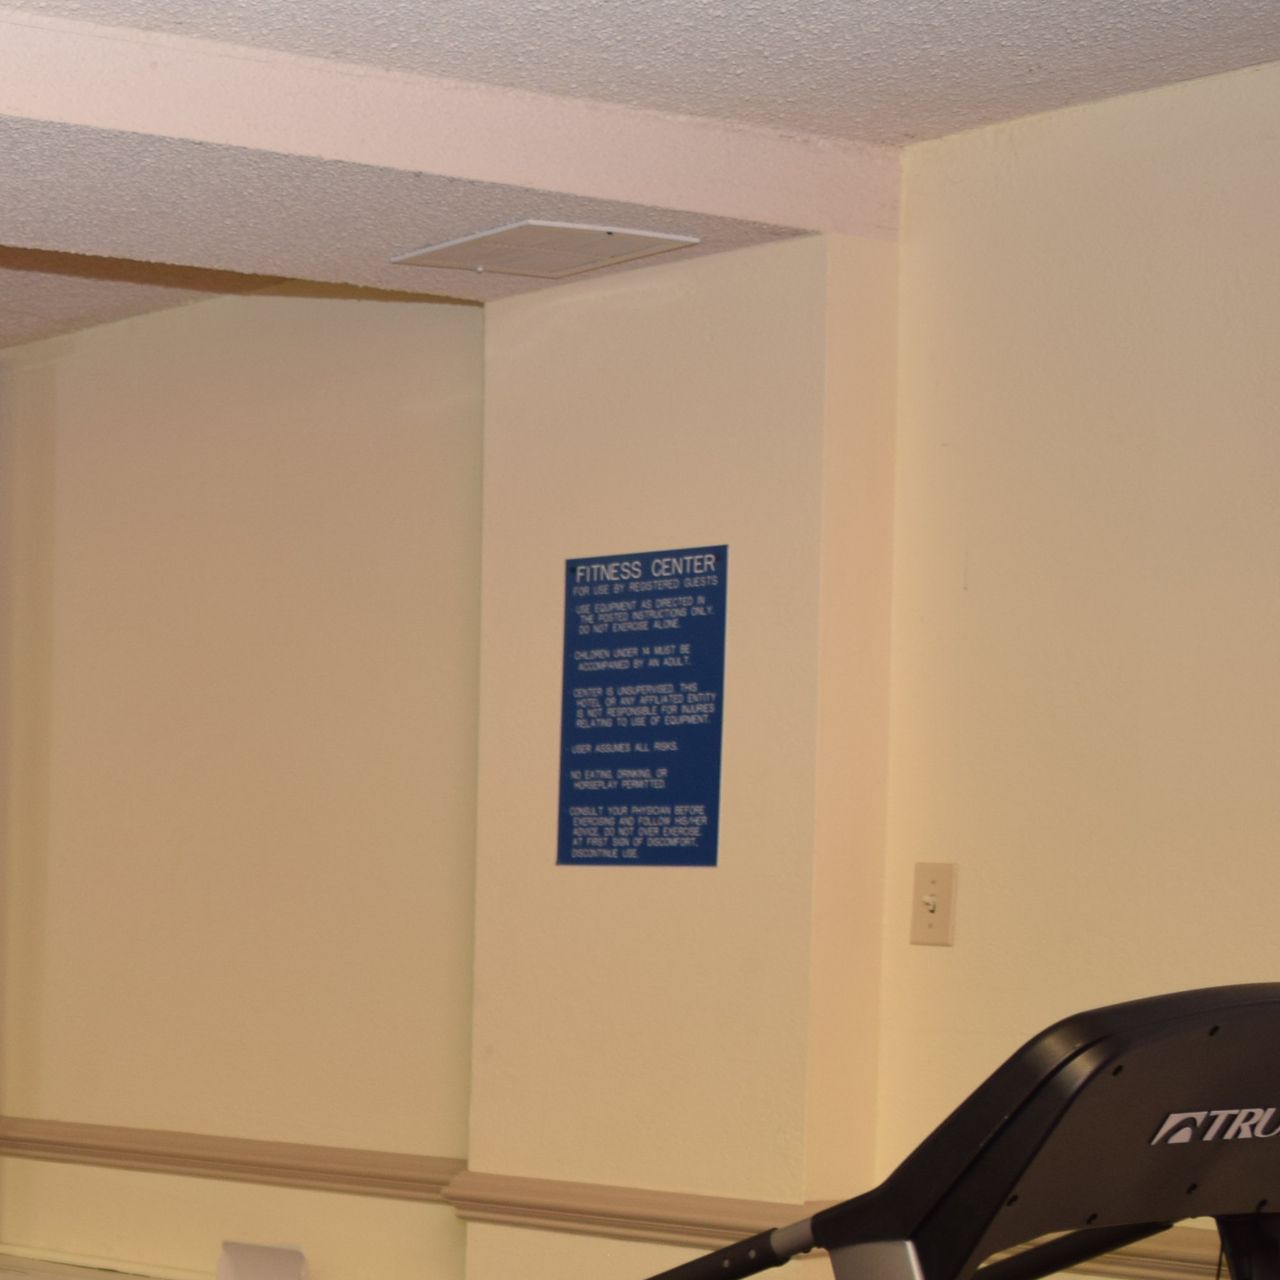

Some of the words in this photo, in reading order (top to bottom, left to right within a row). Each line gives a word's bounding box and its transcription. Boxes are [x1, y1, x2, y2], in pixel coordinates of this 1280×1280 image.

[576, 561, 641, 583] FITNESS
[651, 554, 716, 577] CENTER
[573, 586, 589, 597] FOR
[593, 585, 609, 595] USE
[614, 583, 625, 593] BY
[629, 579, 680, 592] REGISTERED
[683, 575, 718, 588] GUESTS
[594, 601, 636, 613] EQUIPMENT
[641, 600, 652, 609] AS
[655, 597, 693, 608] DIRECTED
[697, 596, 705, 605] IN
[580, 615, 594, 624] THE
[598, 612, 629, 623] POSTED
[632, 608, 687, 620] INSTRUCTIONS
[578, 625, 590, 635] DO
[593, 624, 608, 634] NOT
[612, 621, 649, 632] EXERCISE
[574, 649, 610, 660] CHILDREN
[613, 647, 638, 658] UNDER
[653, 645, 675, 655] MUST
[680, 644, 690, 654] BE
[633, 659, 644, 668] BY
[648, 658, 659, 667] AN
[572, 688, 602, 698] CENTER
[606, 687, 614, 696] IS
[680, 683, 697, 693] THIS
[605, 698, 616, 706] OR
[620, 697, 636, 706] ANY
[640, 695, 684, 705] AFFILIATED
[687, 693, 716, 703] ENTITY
[576, 709, 584, 718] IS
[587, 709, 602, 717] NOT
[606, 706, 658, 716] RESPONSIBLE
[661, 705, 678, 714] FOR
[575, 718, 613, 728] RELATING
[616, 718, 627, 727] TO
[631, 717, 646, 726] USE
[650, 717, 660, 726] OF
[571, 744, 592, 753] USER
[635, 742, 650, 752] ALL
[570, 771, 581, 779] NO
[656, 769, 668, 778] OR
[573, 780, 618, 789] HORSEPLAY
[569, 807, 603, 815] CONSULT
[607, 806, 628, 815] YOUR
[631, 806, 671, 815] PHYSICIAN
[674, 806, 705, 815] BEFORE
[619, 817, 635, 826] AND
[638, 817, 671, 826] FOLLOW
[604, 828, 615, 836] DO
[618, 828, 634, 836] NOT
[573, 838, 582, 846] AT
[587, 838, 608, 846] FIRST
[612, 838, 629, 846] SIGN
[633, 838, 643, 846] OF
